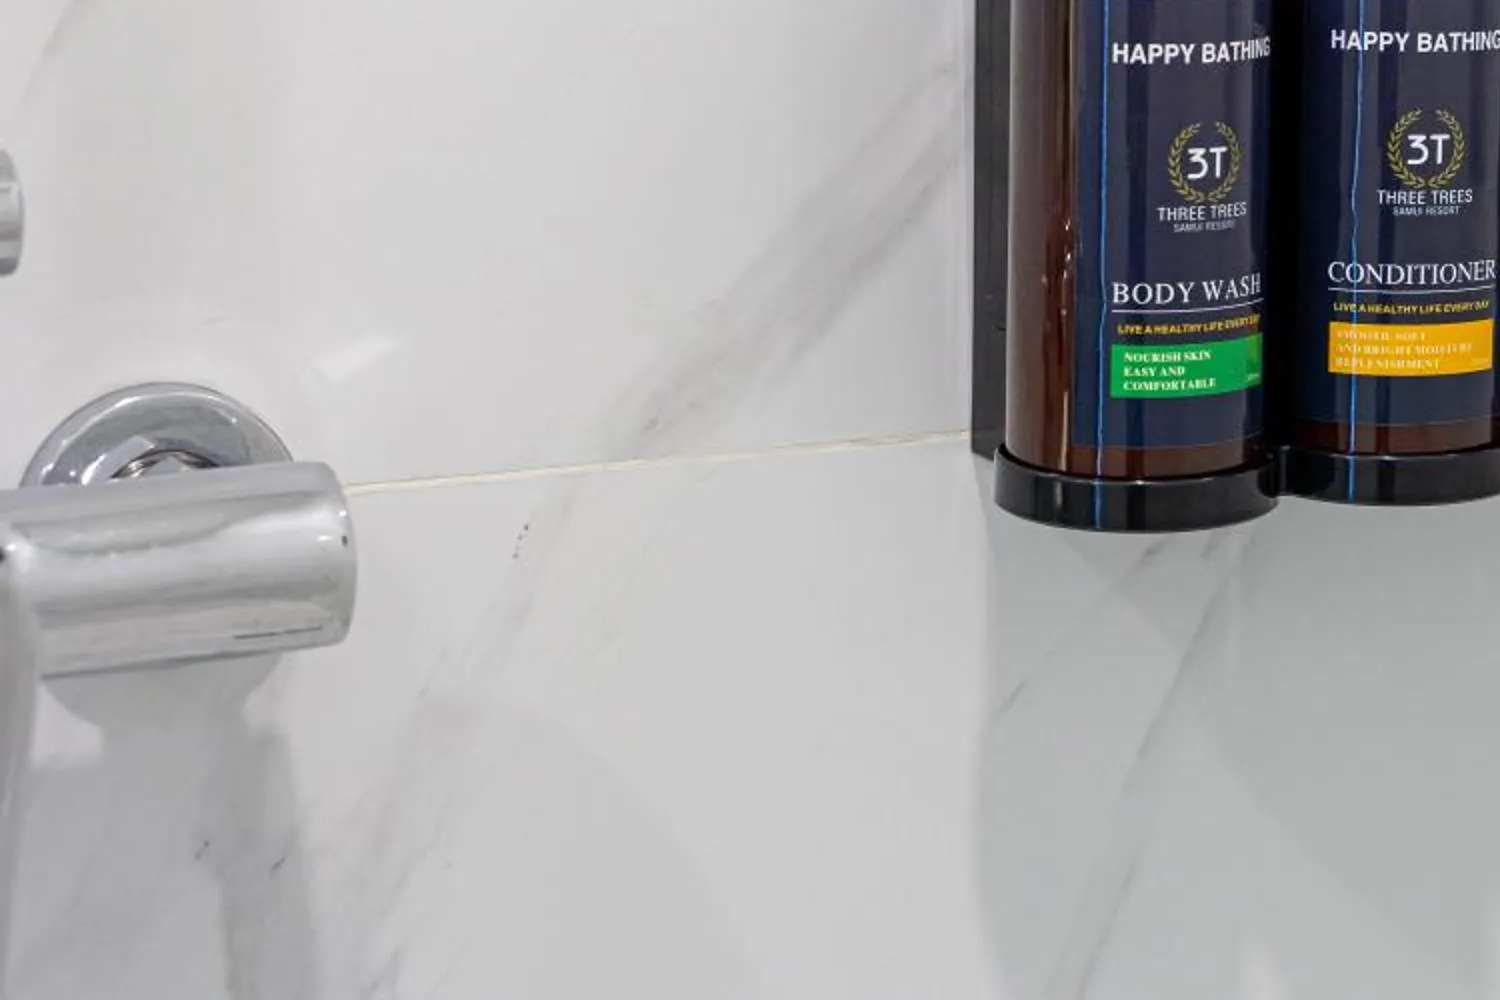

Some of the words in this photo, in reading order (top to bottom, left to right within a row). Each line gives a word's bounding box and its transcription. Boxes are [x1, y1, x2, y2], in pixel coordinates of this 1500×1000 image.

[1112, 42, 1195, 65] HAPPY
[1201, 36, 1271, 64] BATHING
[1331, 29, 1409, 52] HAPPY
[1407, 133, 1450, 166] 3T
[1187, 146, 1228, 180] 3T
[1376, 188, 1427, 206] THREE
[1431, 187, 1474, 205] TREES
[1156, 204, 1207, 222] THREE
[1210, 201, 1247, 219] TREES
[1327, 259, 1497, 286] CONDITIONER
[1111, 280, 1196, 304] BODY
[1201, 272, 1262, 302] WASH
[1333, 301, 1356, 313] LIVE
[1358, 303, 1367, 314] A
[1367, 303, 1417, 316] HEALTHY
[1419, 303, 1443, 315] LIFE
[1117, 324, 1142, 335] LIVE
[1143, 324, 1153, 335] A
[1123, 351, 1181, 362] NOURISH
[1183, 350, 1211, 361] SKIN
[1123, 366, 1158, 377] EASY
[1160, 365, 1185, 376] AND
[1123, 377, 1216, 391] COMFORTABLE
